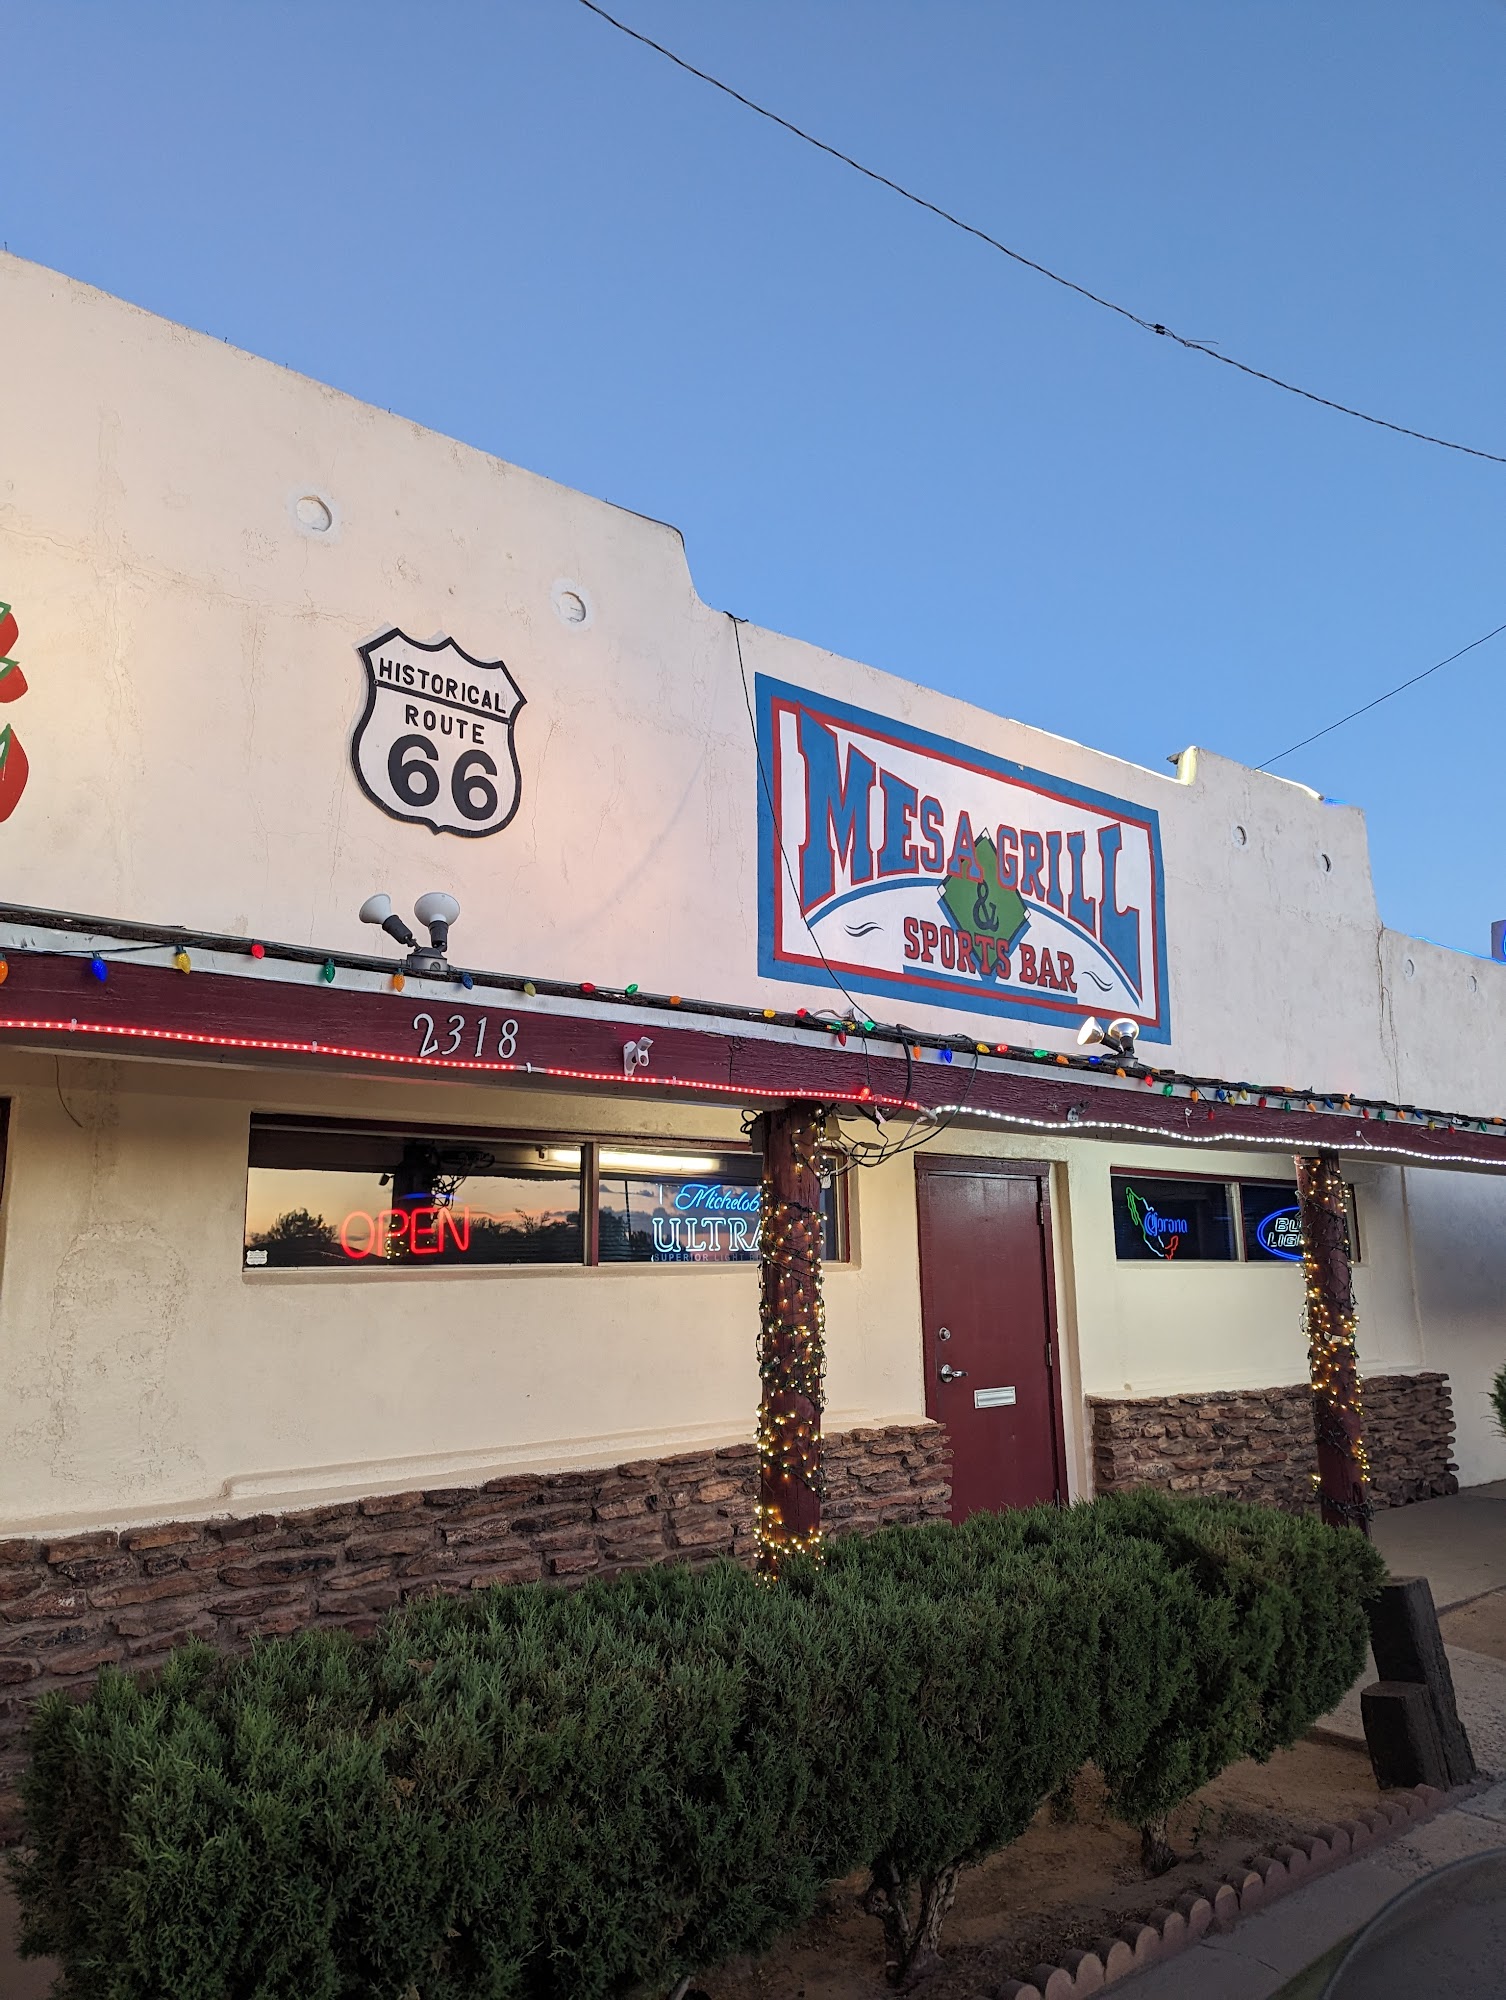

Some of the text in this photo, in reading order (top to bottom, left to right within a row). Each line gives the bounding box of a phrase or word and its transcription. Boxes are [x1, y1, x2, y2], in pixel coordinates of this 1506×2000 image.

[379, 657, 506, 714] HISTORICAL
[405, 704, 485, 745] ROUTE
[387, 733, 499, 821] 66
[796, 702, 1143, 1002] MESA GRILL
[972, 881, 999, 932] &
[903, 916, 1078, 994] SPORTS BAR
[412, 1013, 519, 1059] 2318
[674, 1183, 761, 1212] Michelob
[340, 1206, 470, 1259] OPEN
[1144, 1211, 1187, 1236] Corona
[1267, 1232, 1302, 1247] LIG
[1275, 1217, 1301, 1232] BU
[654, 1253, 709, 1262] SUPERIOR
[714, 1253, 744, 1262] LIGHT
